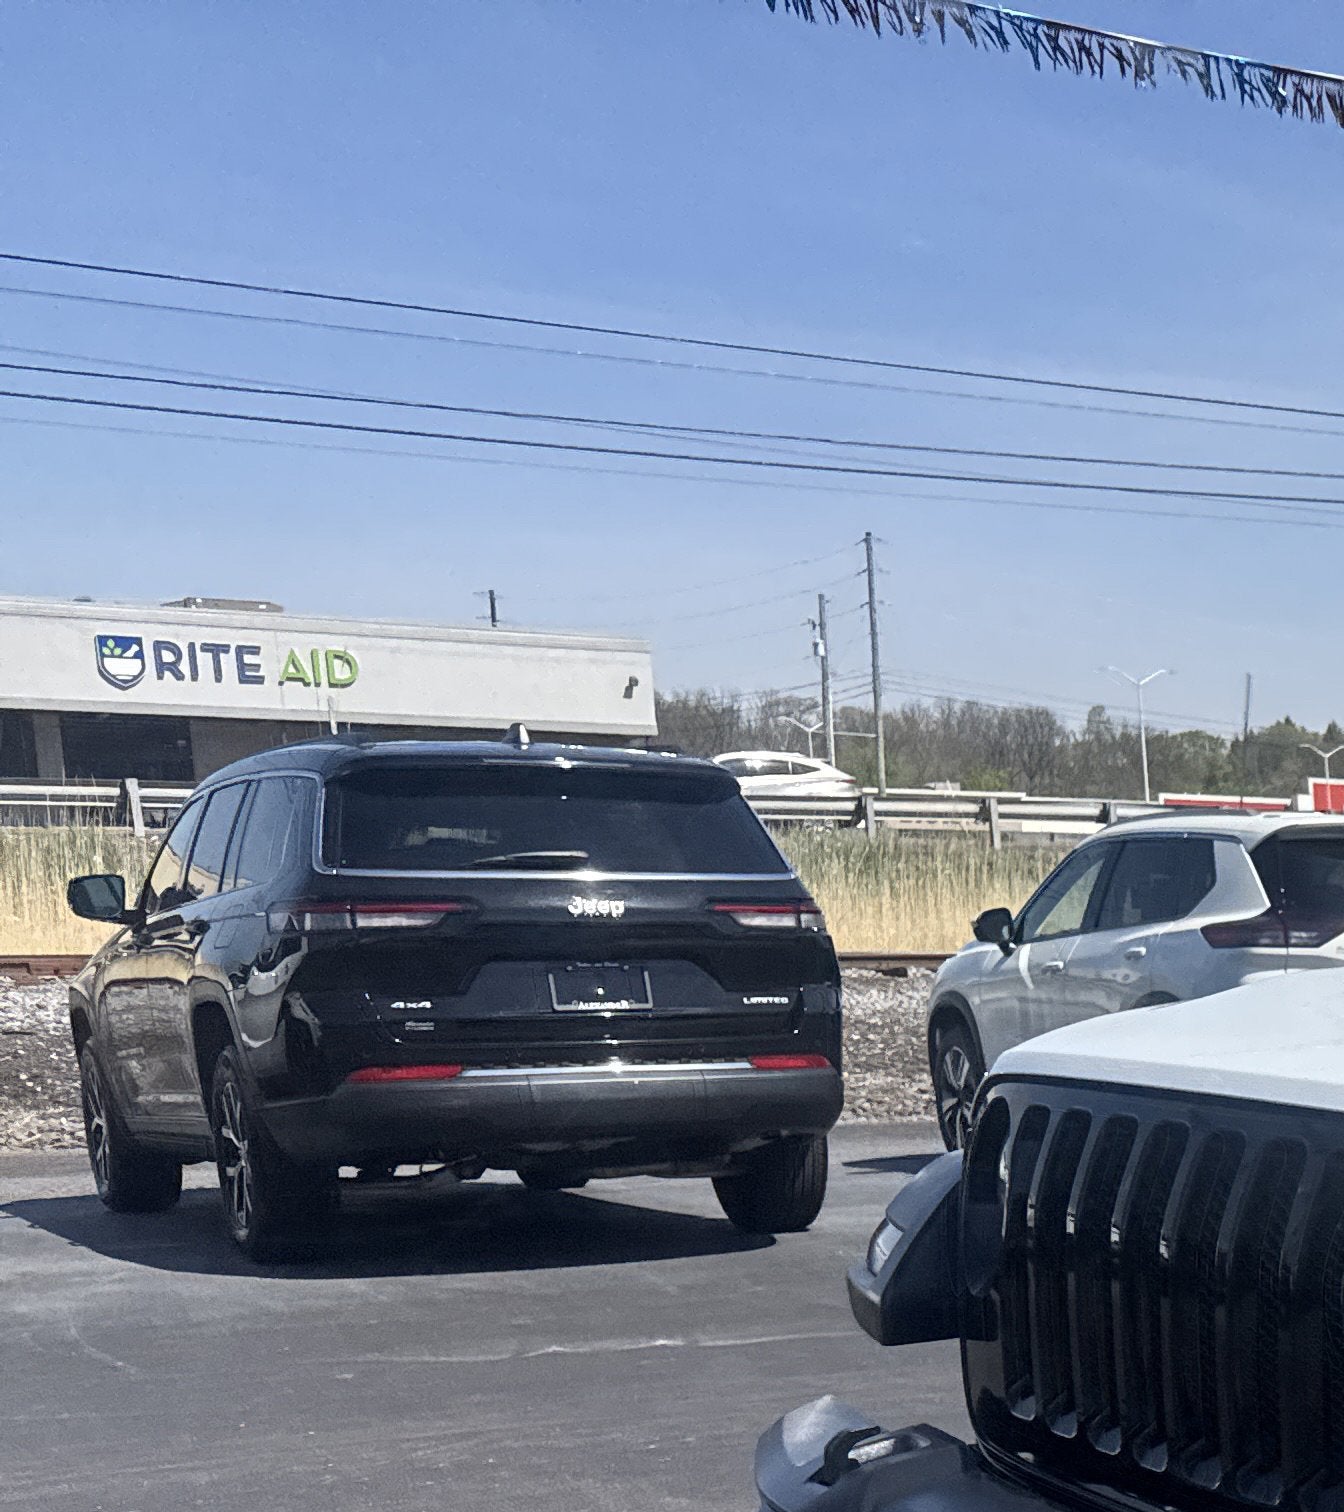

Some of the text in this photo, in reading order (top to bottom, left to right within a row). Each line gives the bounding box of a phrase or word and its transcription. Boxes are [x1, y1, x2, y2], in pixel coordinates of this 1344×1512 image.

[152, 639, 359, 689] RITE AID
[567, 896, 625, 918] Jeep
